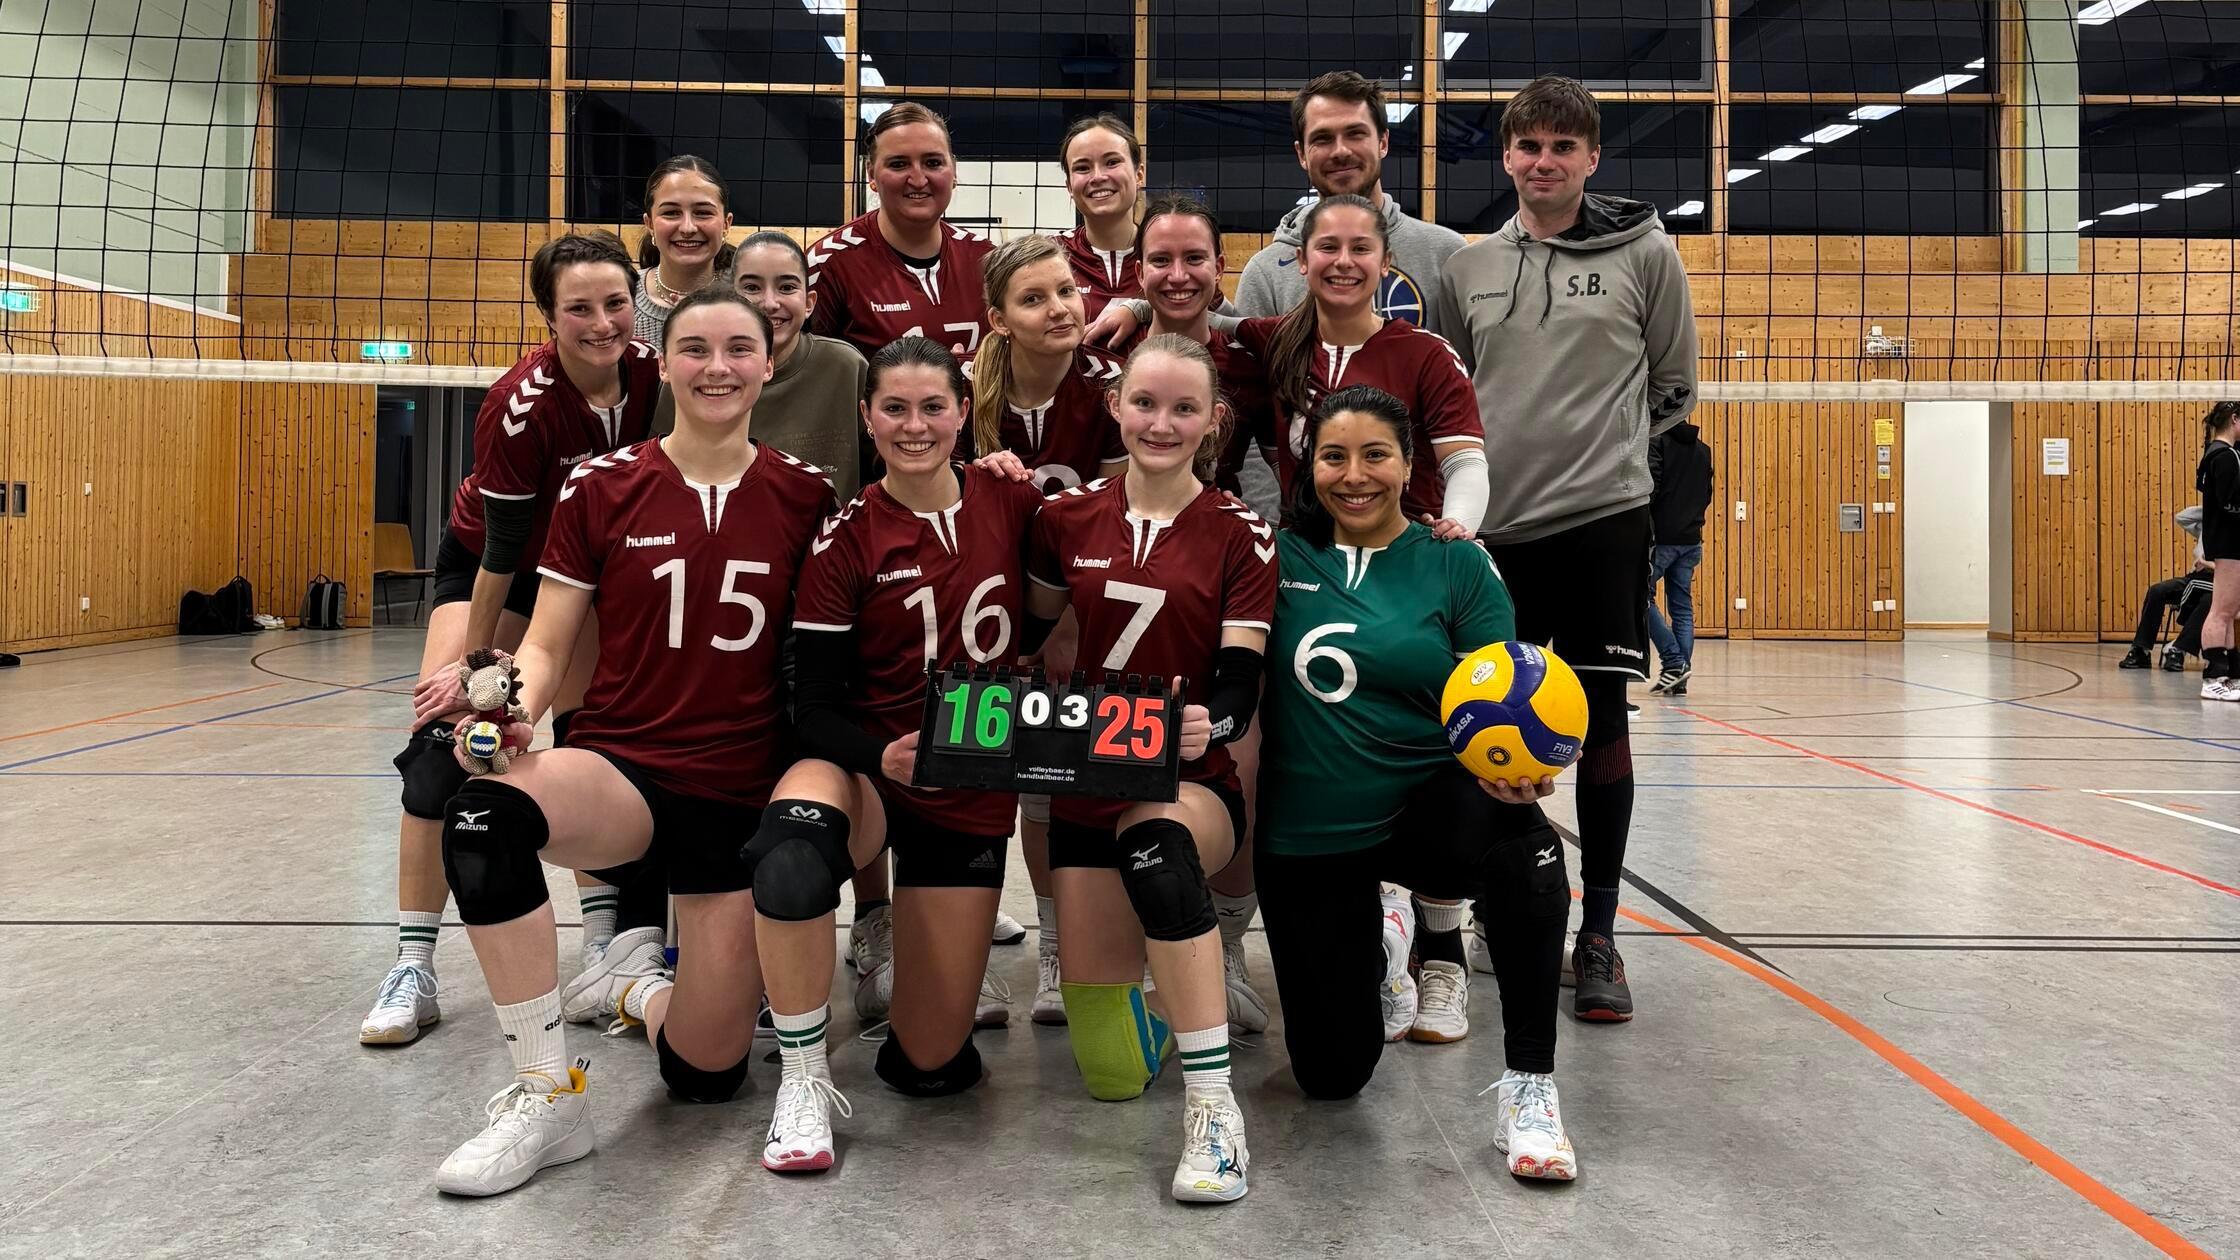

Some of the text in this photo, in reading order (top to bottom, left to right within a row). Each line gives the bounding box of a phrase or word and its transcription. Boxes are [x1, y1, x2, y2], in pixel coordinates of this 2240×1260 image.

[1566, 273, 1607, 297] S.B.
[870, 300, 912, 313] hummel
[902, 321, 980, 352] 7
[626, 532, 676, 548] hummel
[877, 565, 923, 583] hummel
[1073, 555, 1112, 569] hummel
[1279, 579, 1321, 592] hummel
[652, 558, 771, 652] 15
[903, 574, 1012, 670] 16
[1102, 579, 1167, 671] 7
[1294, 622, 1358, 703] 6
[944, 683, 1013, 748] 16
[1093, 695, 1166, 760] 25
[1448, 712, 1475, 746] MIKASA
